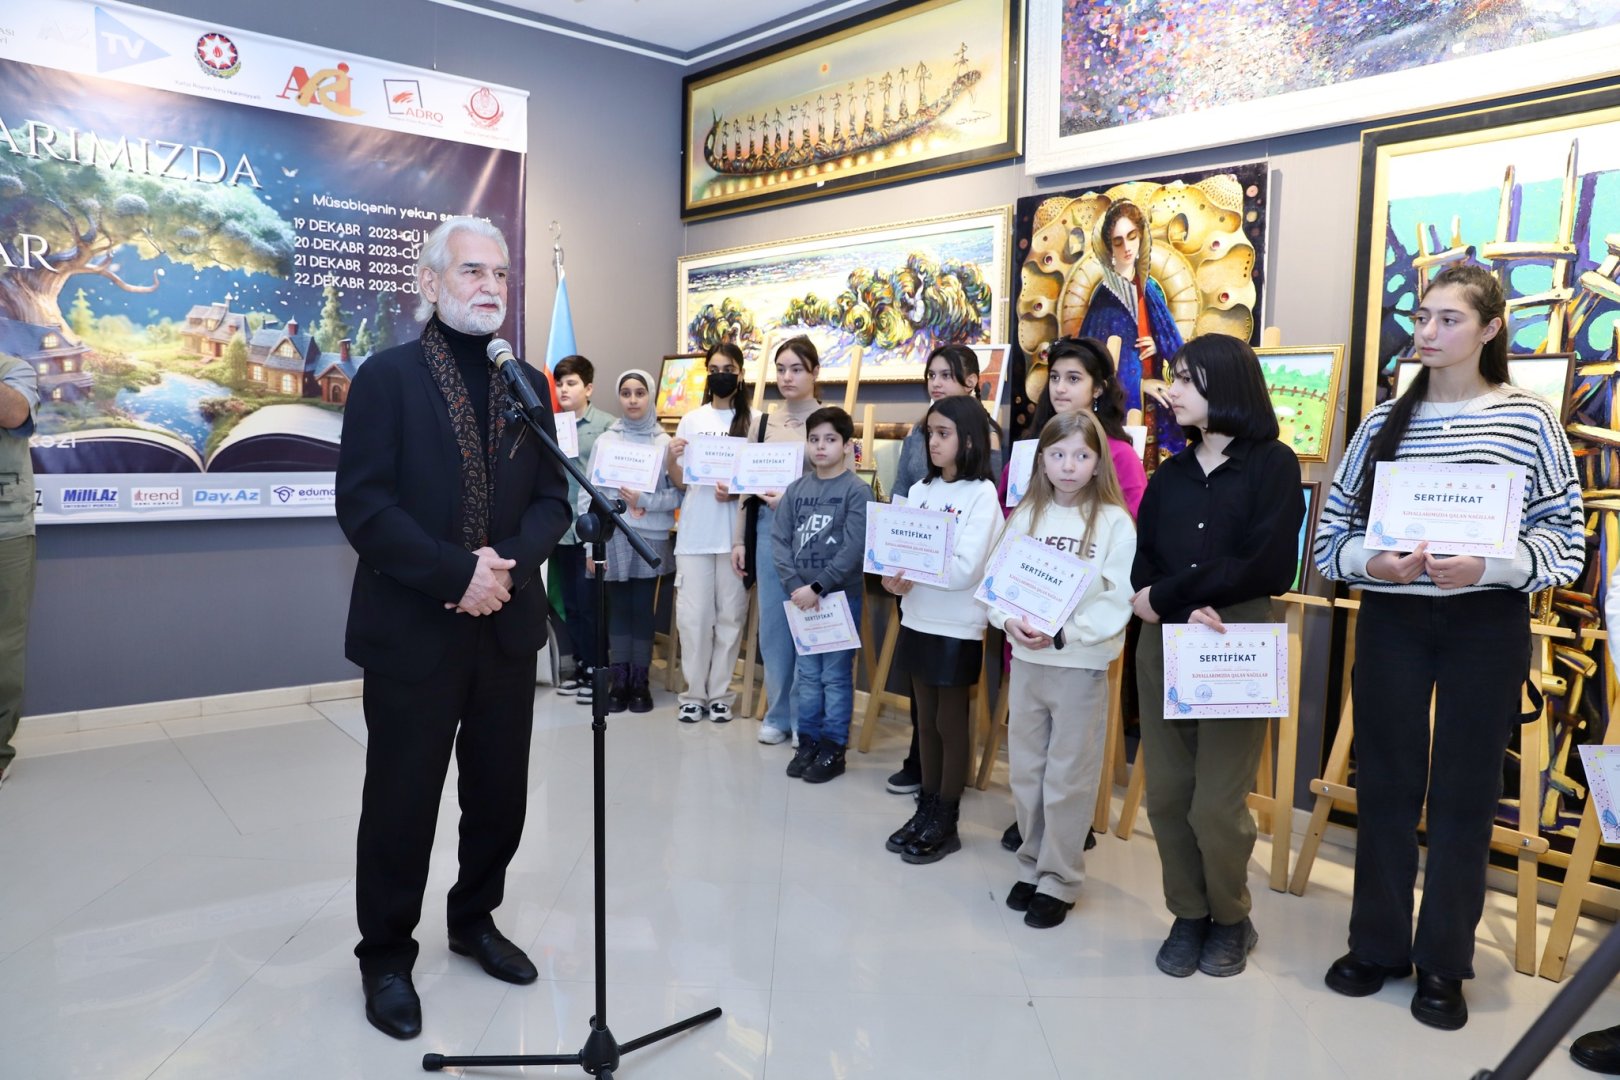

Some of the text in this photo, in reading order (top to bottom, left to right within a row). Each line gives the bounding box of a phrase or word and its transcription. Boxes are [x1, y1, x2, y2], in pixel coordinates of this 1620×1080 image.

[405, 107, 444, 123] ADRQ
[312, 194, 397, 216] Müsabiqənin
[400, 207, 437, 221] yekun
[294, 217, 306, 230] 19
[309, 219, 361, 236] DEKABR
[294, 236, 309, 249] 20
[313, 237, 365, 255] DEKABR
[294, 254, 307, 266] 21
[309, 255, 361, 272] DEKABR
[294, 273, 309, 285] 22
[313, 274, 365, 290] DEKABR
[63, 488, 118, 502] Milli.Az
[134, 488, 179, 501] trend
[195, 490, 259, 503] Day.Az
[1414, 492, 1484, 504] SERTİFİKAT
[891, 528, 932, 541] SERTİFİKAT
[1020, 562, 1064, 587] SERTİFİKAT
[1199, 652, 1257, 663] SERTİFİKAT
